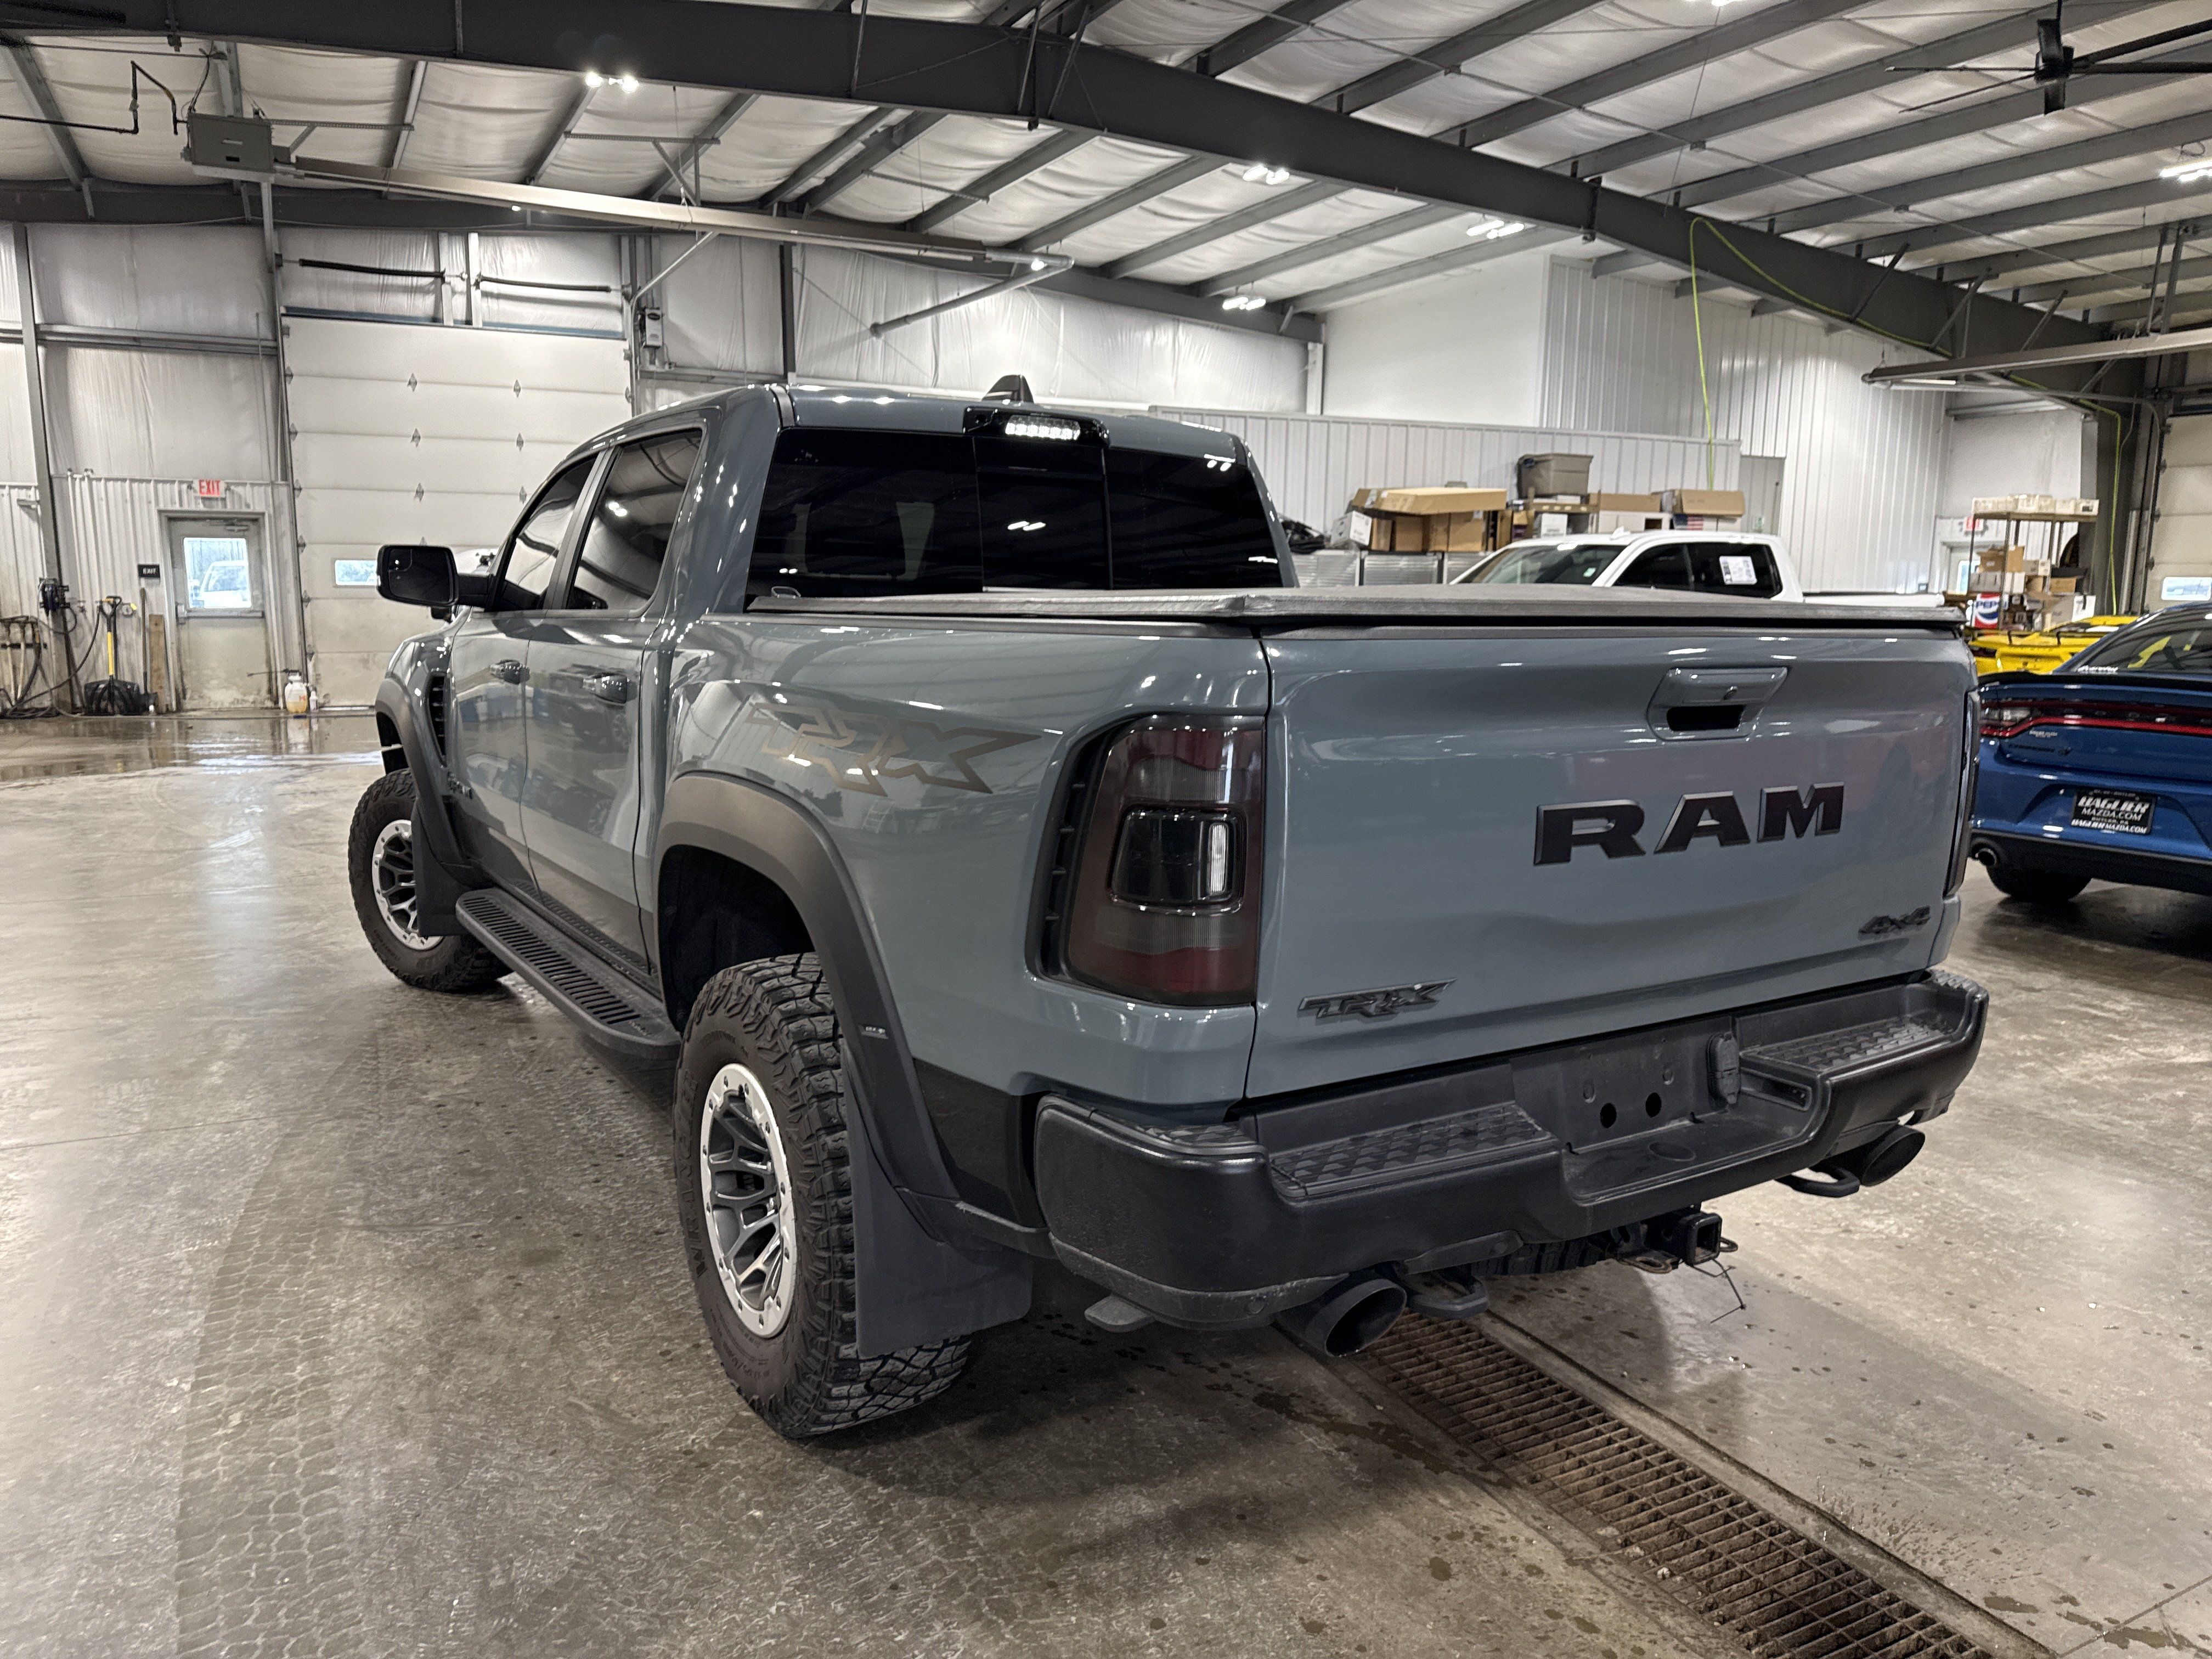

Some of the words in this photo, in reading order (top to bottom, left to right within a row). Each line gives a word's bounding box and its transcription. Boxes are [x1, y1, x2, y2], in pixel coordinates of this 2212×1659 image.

[199, 479, 220, 496] EXIT
[1976, 600, 2007, 609] PEPI
[2081, 808, 2143, 821] MAZDA.COM
[1534, 781, 1845, 866] RAM
[1299, 978, 1457, 1018] TRX
